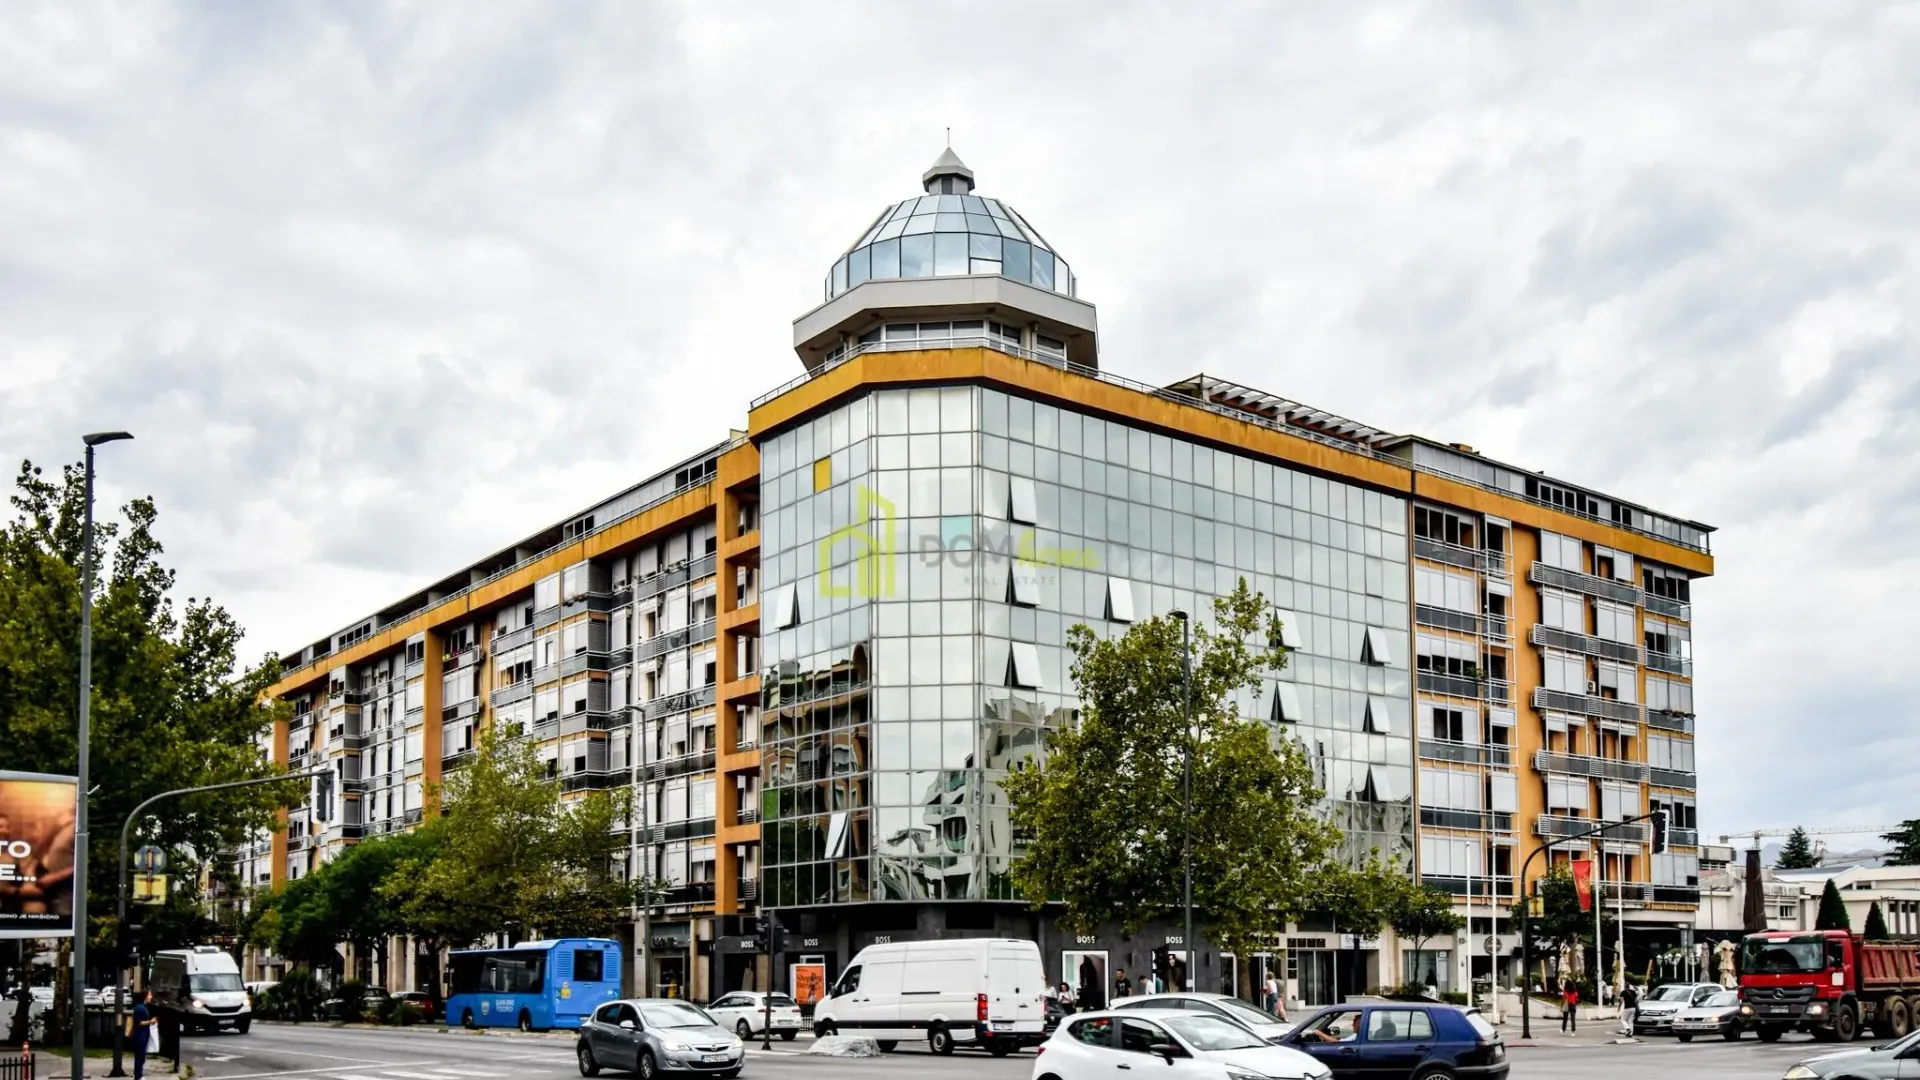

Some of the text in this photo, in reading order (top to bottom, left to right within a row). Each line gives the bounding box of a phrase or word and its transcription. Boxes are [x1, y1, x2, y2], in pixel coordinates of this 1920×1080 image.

[804, 938, 819, 947] BOSS
[875, 936, 891, 944] BOSS
[1076, 935, 1096, 944] BOSS
[1165, 936, 1183, 944] BOSS
[741, 940, 754, 949] BOSS
